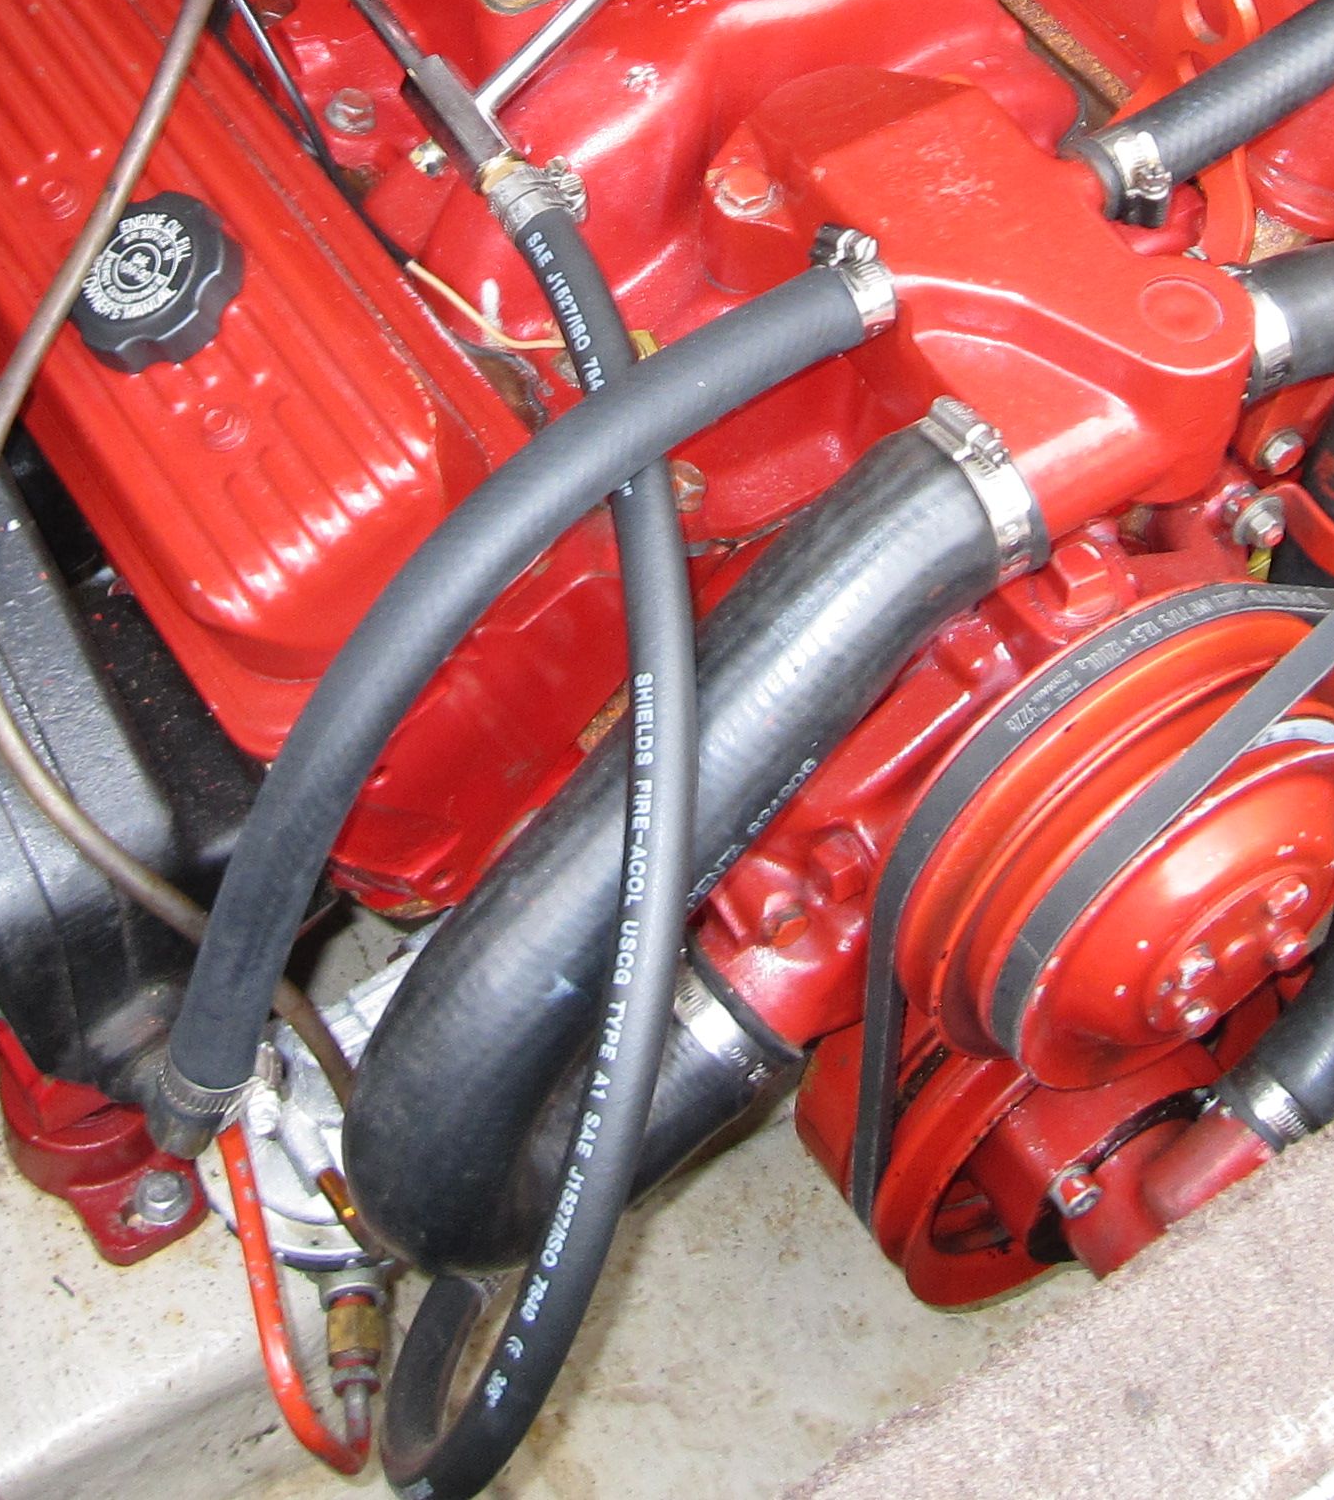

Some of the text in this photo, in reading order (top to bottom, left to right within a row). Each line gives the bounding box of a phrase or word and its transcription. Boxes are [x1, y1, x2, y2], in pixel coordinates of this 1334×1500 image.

[119, 213, 192, 262] ENGINE OIL FILL
[140, 230, 172, 249] SERVICE
[525, 231, 555, 268] SAE
[82, 276, 178, 320] OWNER'S MANUAL
[634, 672, 655, 767] SHIELDS
[624, 779, 653, 908] FIRE-ACOL
[612, 919, 641, 987] USCG
[598, 1000, 628, 1062] TYPE
[589, 1069, 611, 1100] A1
[575, 1110, 603, 1160] SAE
[540, 1165, 586, 1268] J1527/ISO
[520, 1273, 550, 1323] 7840
